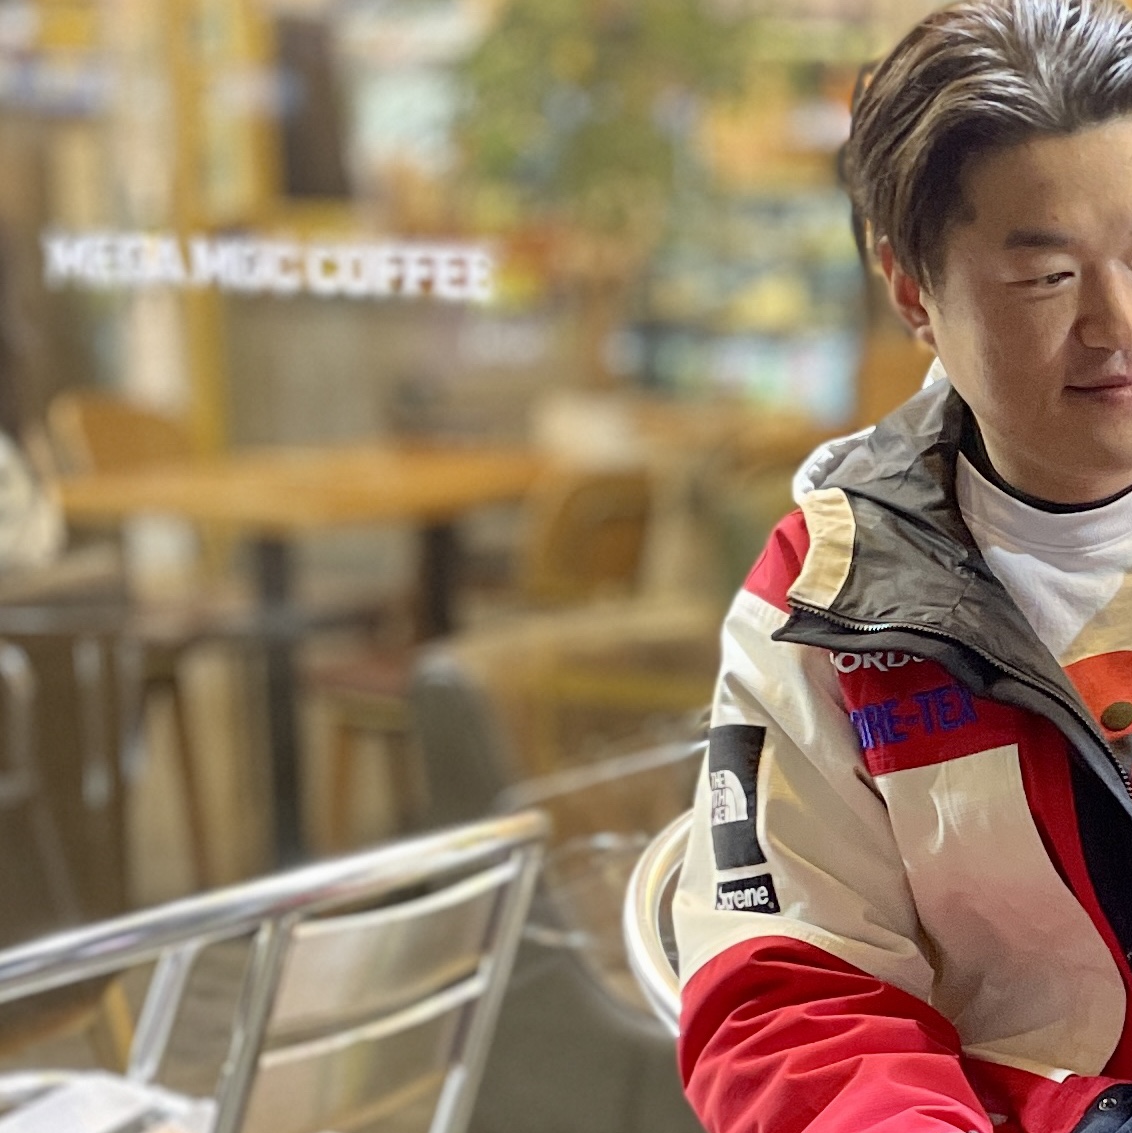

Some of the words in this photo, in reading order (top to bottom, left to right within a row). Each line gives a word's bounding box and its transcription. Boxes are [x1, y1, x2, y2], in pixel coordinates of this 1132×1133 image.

[42, 233, 187, 288] MEGA
[304, 243, 495, 301] COFFEE
[829, 651, 926, 674] ORD
[849, 682, 978, 750] RE-TEX
